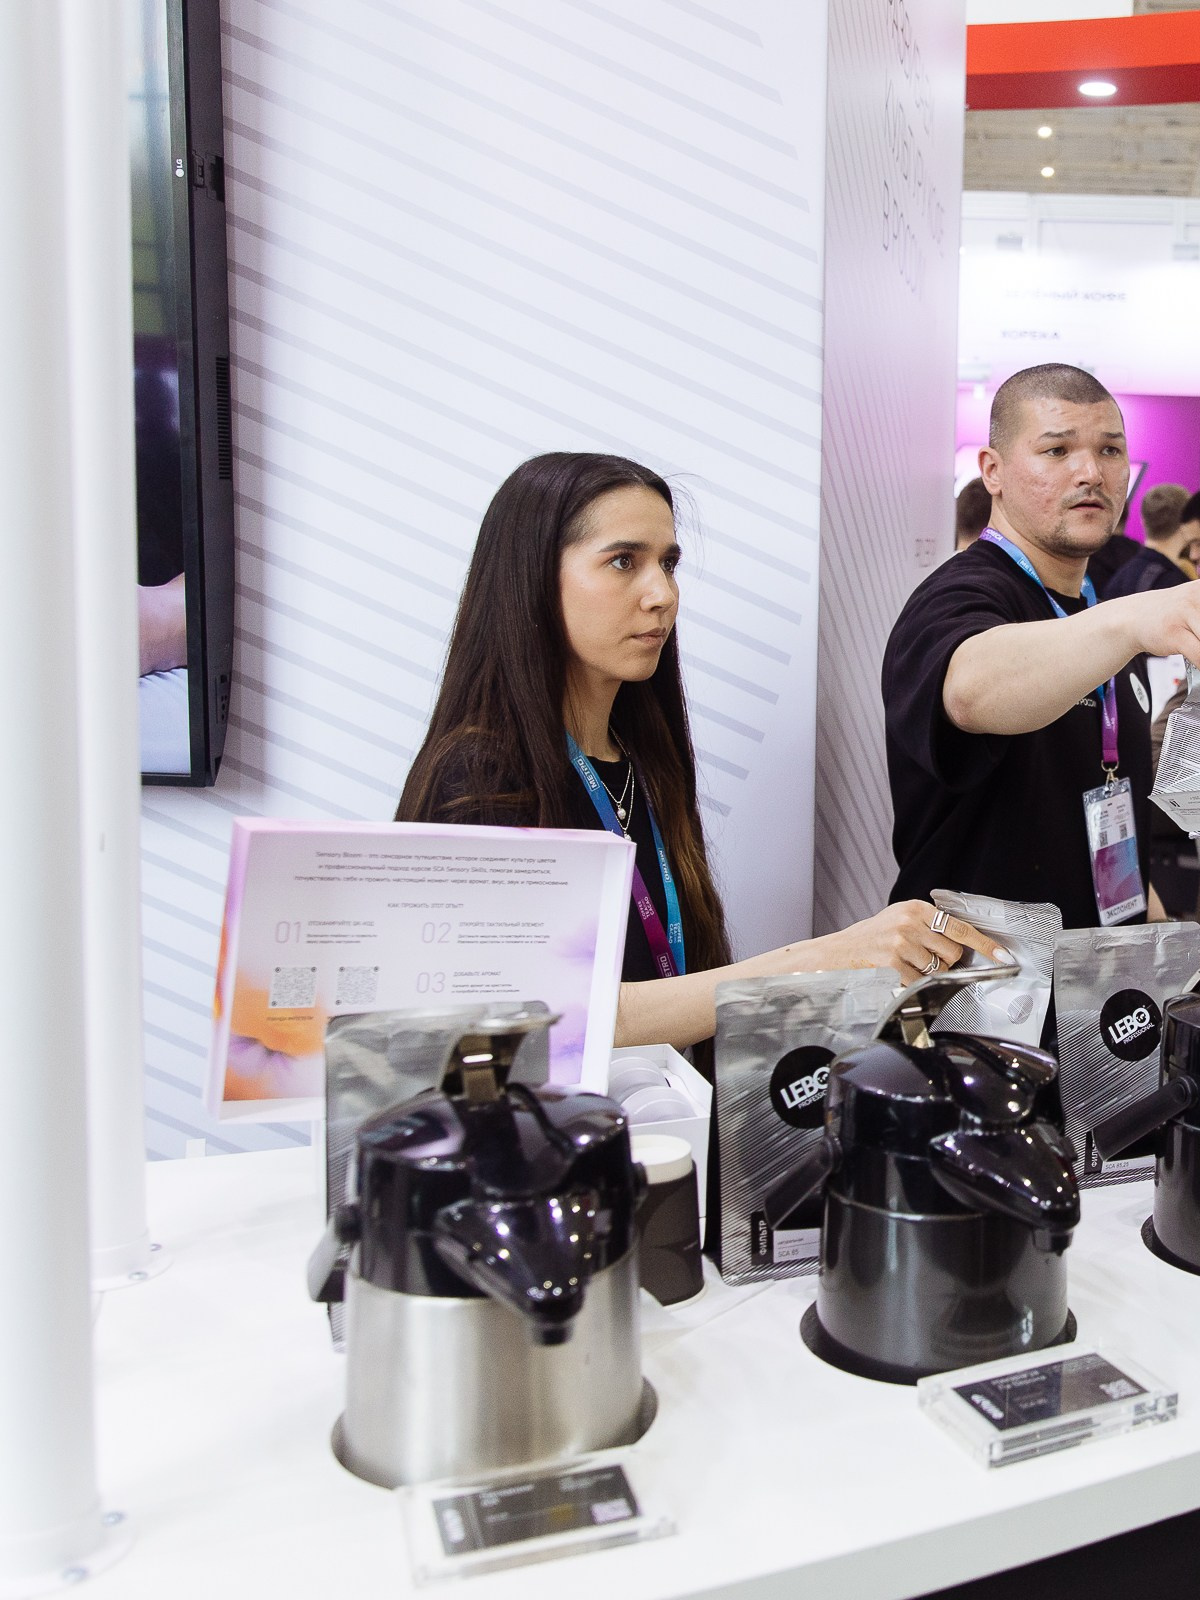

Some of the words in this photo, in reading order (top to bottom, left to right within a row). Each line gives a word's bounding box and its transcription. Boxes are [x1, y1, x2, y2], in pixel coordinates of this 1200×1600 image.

[176, 158, 183, 169] LG
[577, 758, 599, 790] METRO
[659, 849, 671, 881] METRO
[644, 896, 655, 916] CACAO
[274, 921, 301, 944] 01
[422, 921, 452, 944] 02
[659, 955, 672, 978] ETRO
[416, 971, 446, 994] 03
[1108, 1007, 1151, 1045] LEBO
[780, 1066, 831, 1109] LEBO
[758, 1220, 768, 1256] ФИЛЬТР
